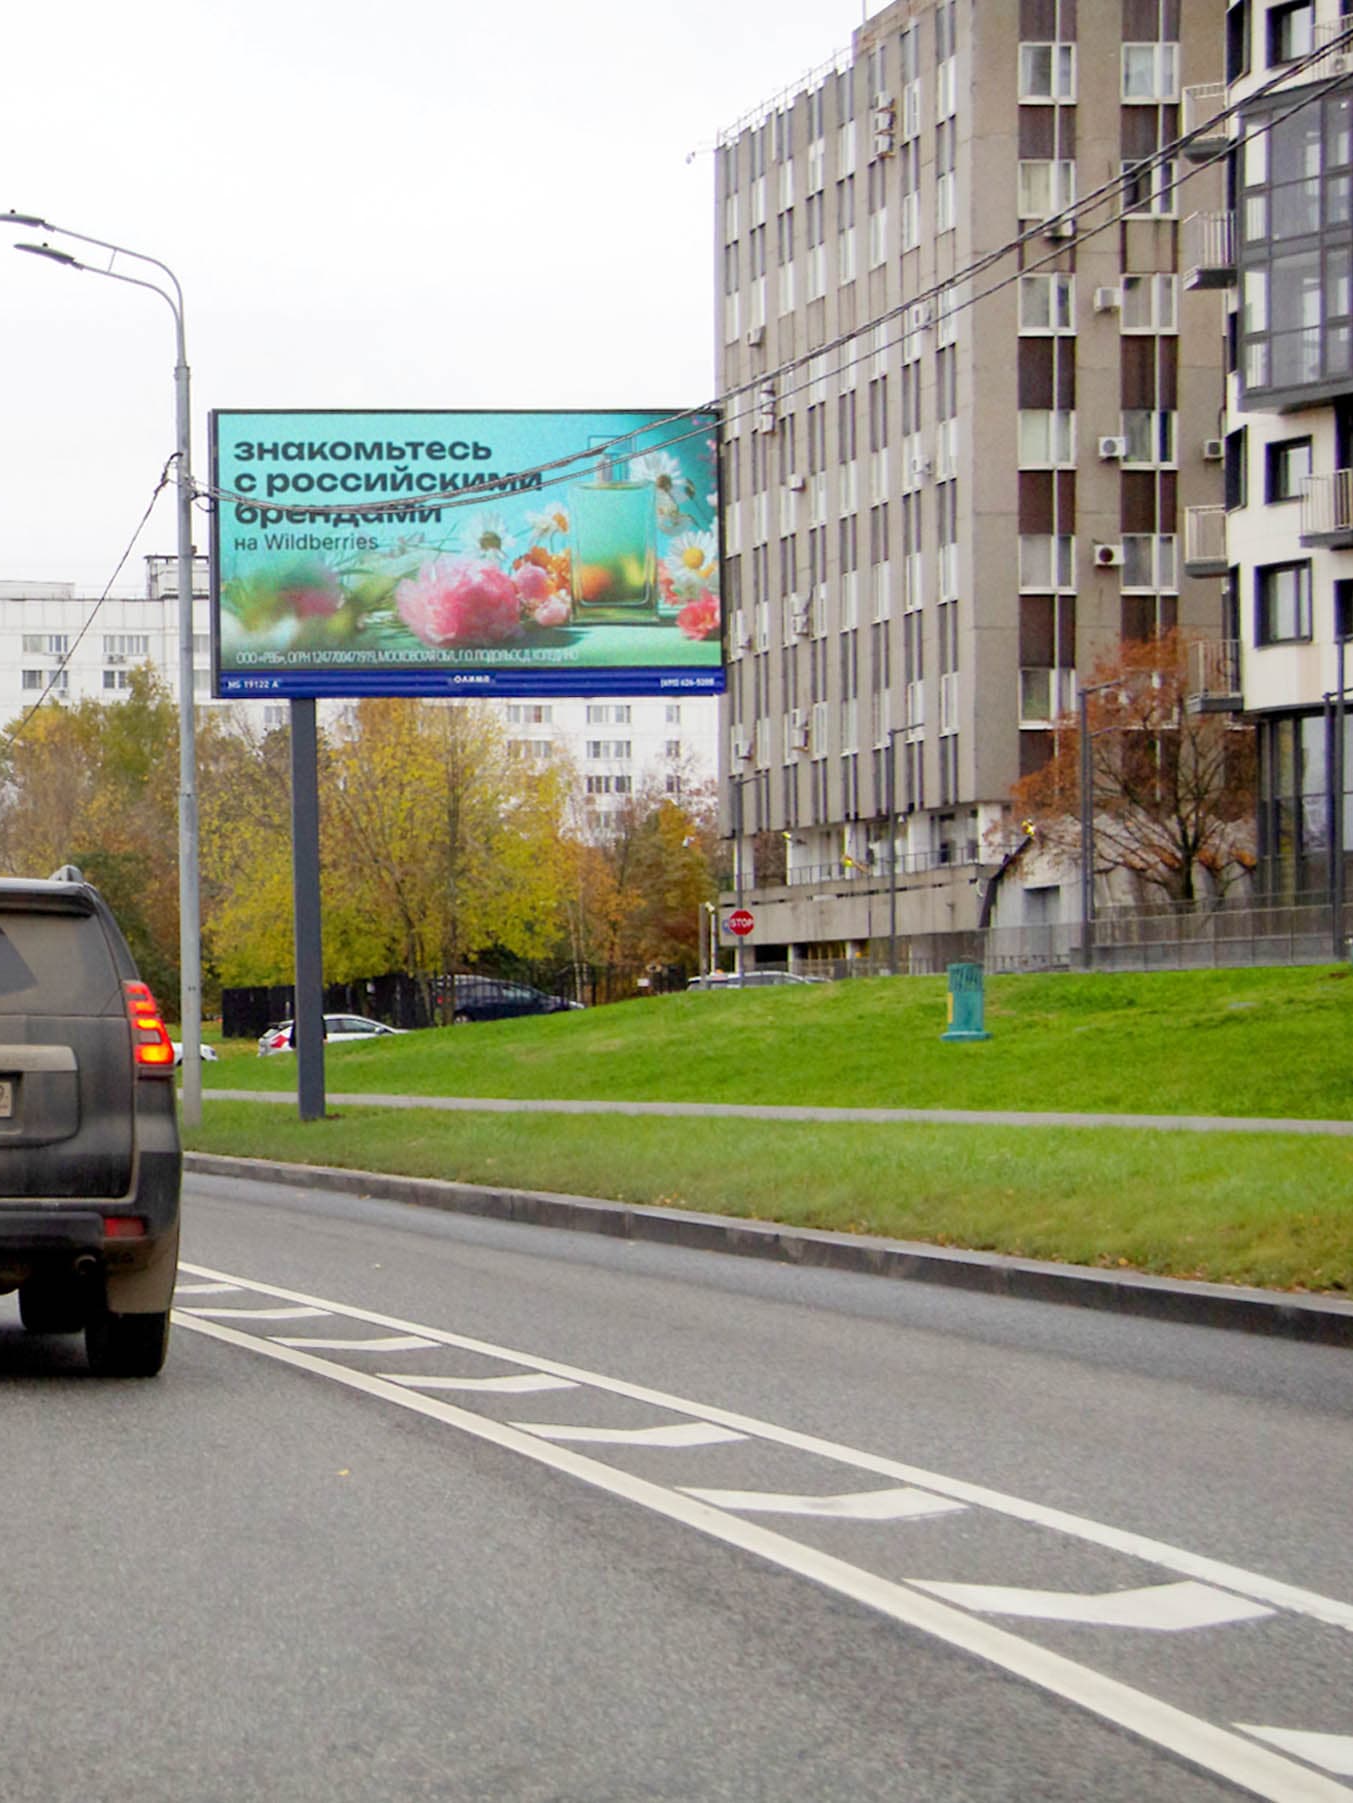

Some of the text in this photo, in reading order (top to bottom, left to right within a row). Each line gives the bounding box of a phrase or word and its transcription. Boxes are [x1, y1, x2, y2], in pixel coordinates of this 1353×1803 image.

[233, 440, 492, 462] знакомьтесь
[233, 464, 543, 498] с российскими
[234, 500, 443, 529] брендами
[234, 532, 379, 551] на Wildberries
[729, 918, 754, 928] STOP
